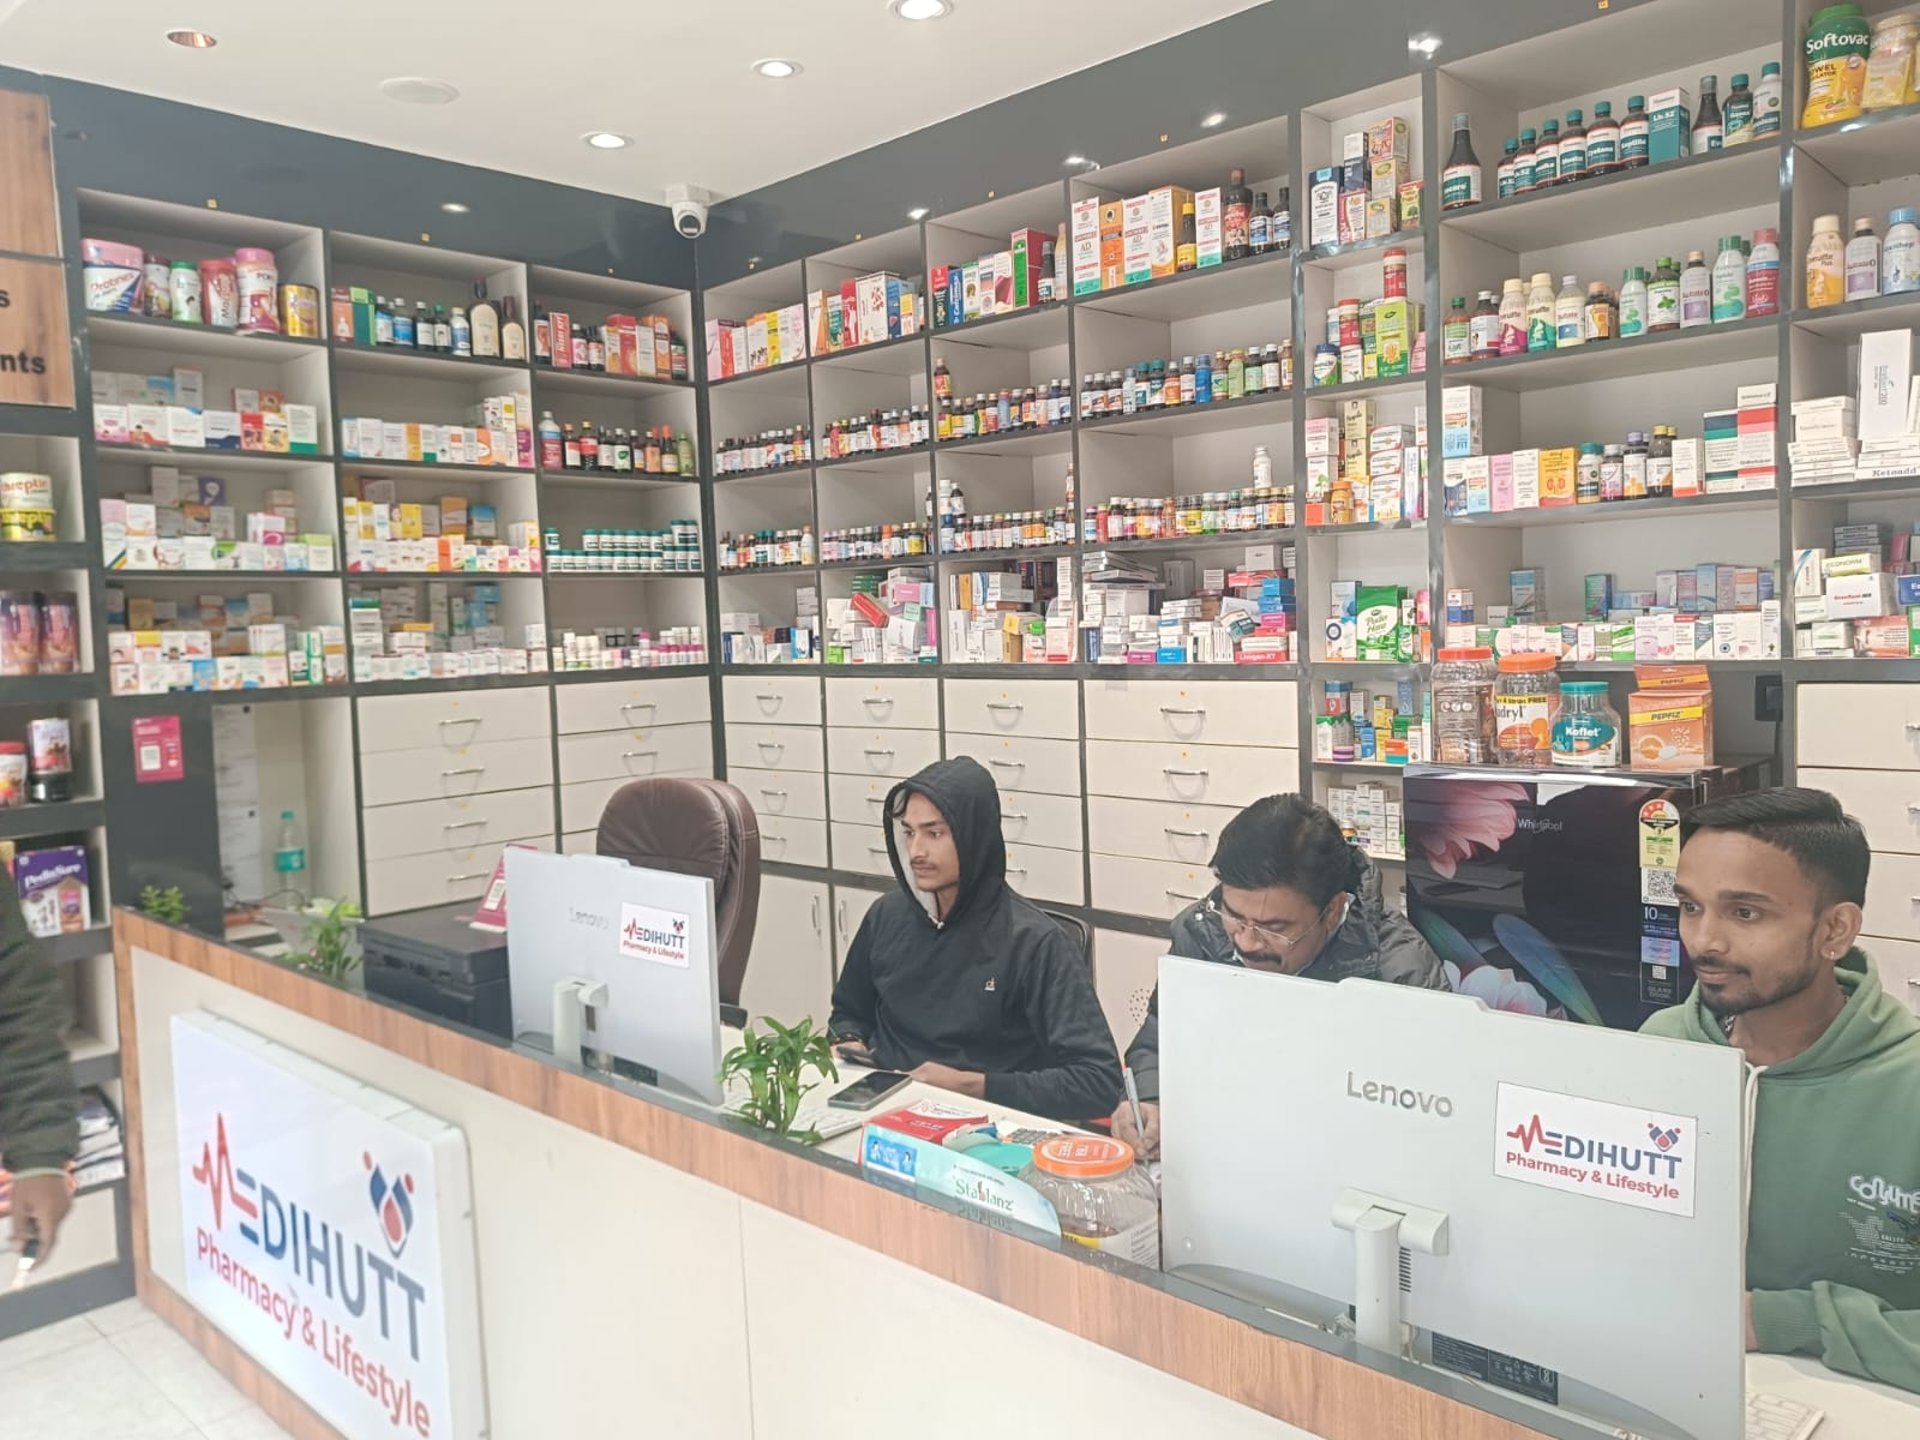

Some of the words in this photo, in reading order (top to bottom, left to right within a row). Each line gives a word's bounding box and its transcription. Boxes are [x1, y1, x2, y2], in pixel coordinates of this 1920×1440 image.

[1806, 33, 1869, 55] Softovac
[1565, 726, 1600, 737] Koflet
[1517, 818, 1563, 833] Whirlpool
[1644, 906, 1658, 921] 10
[1346, 1070, 1454, 1118] Lenovo
[1505, 1151, 1589, 1184] Pharmacy
[1591, 1169, 1603, 1184] &
[1606, 1172, 1680, 1200] Lifestyle
[197, 1226, 297, 1341] Pharmacy
[301, 1306, 318, 1351] &
[321, 1319, 431, 1439] Lifestyle
